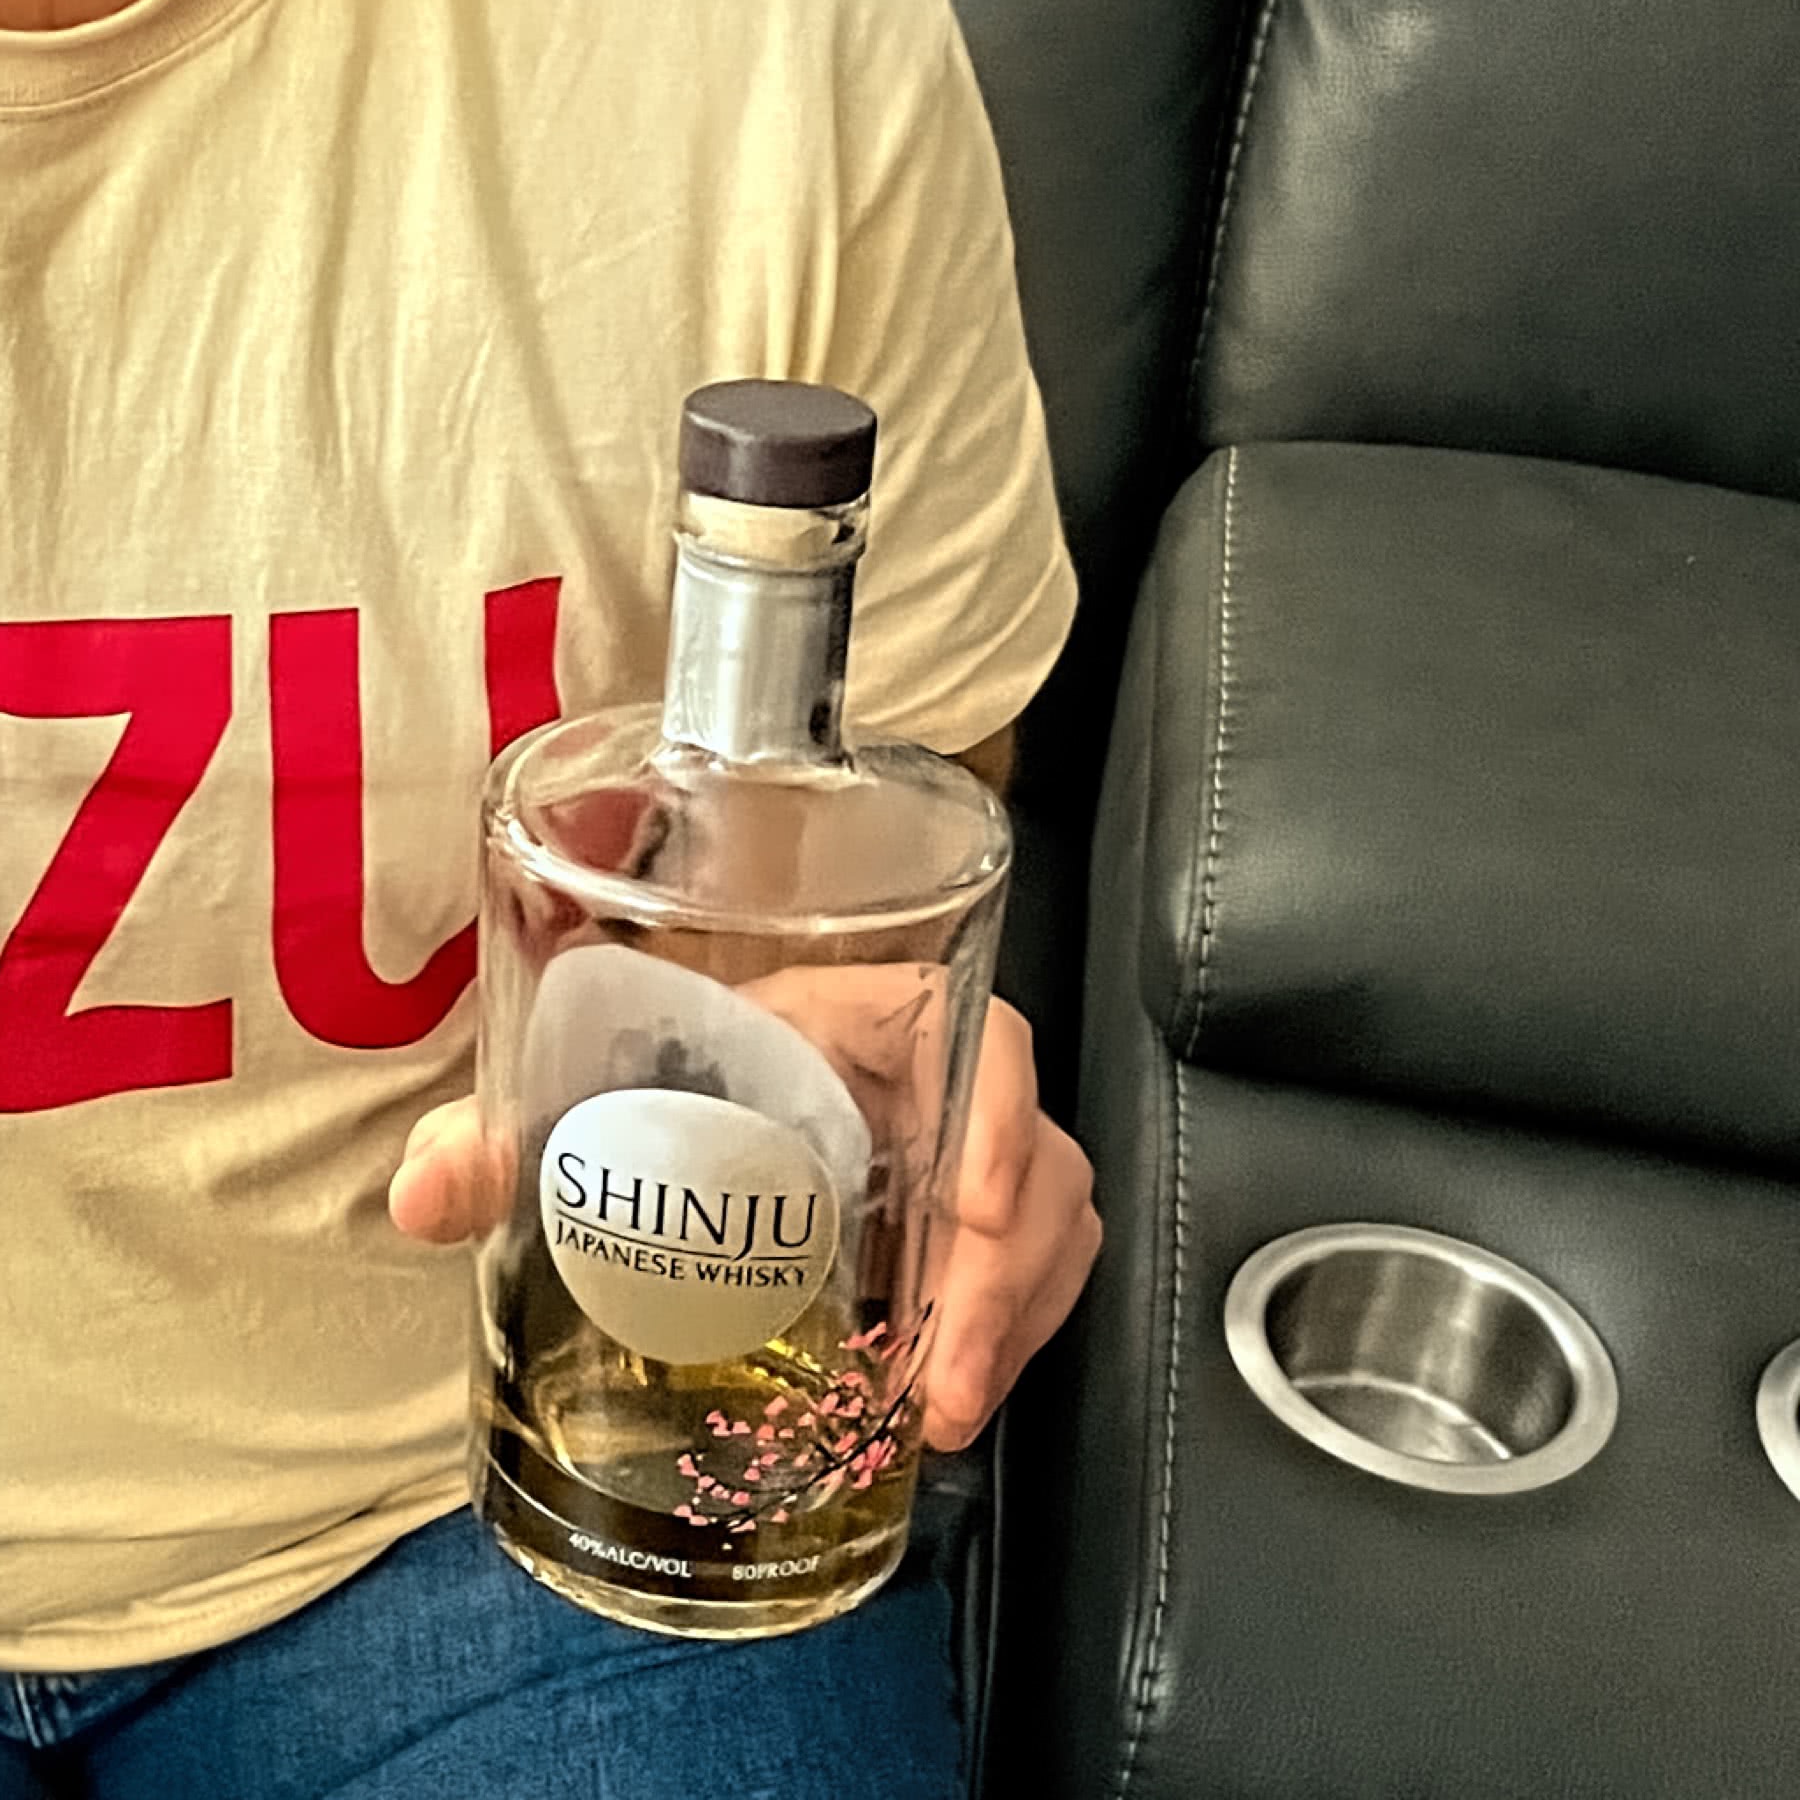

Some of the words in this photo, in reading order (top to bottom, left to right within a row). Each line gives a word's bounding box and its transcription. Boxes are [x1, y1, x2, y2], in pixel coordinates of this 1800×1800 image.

[556, 1152, 817, 1261] SHINJU
[556, 1220, 685, 1280] JAPANESE
[696, 1261, 806, 1288] WHISKY
